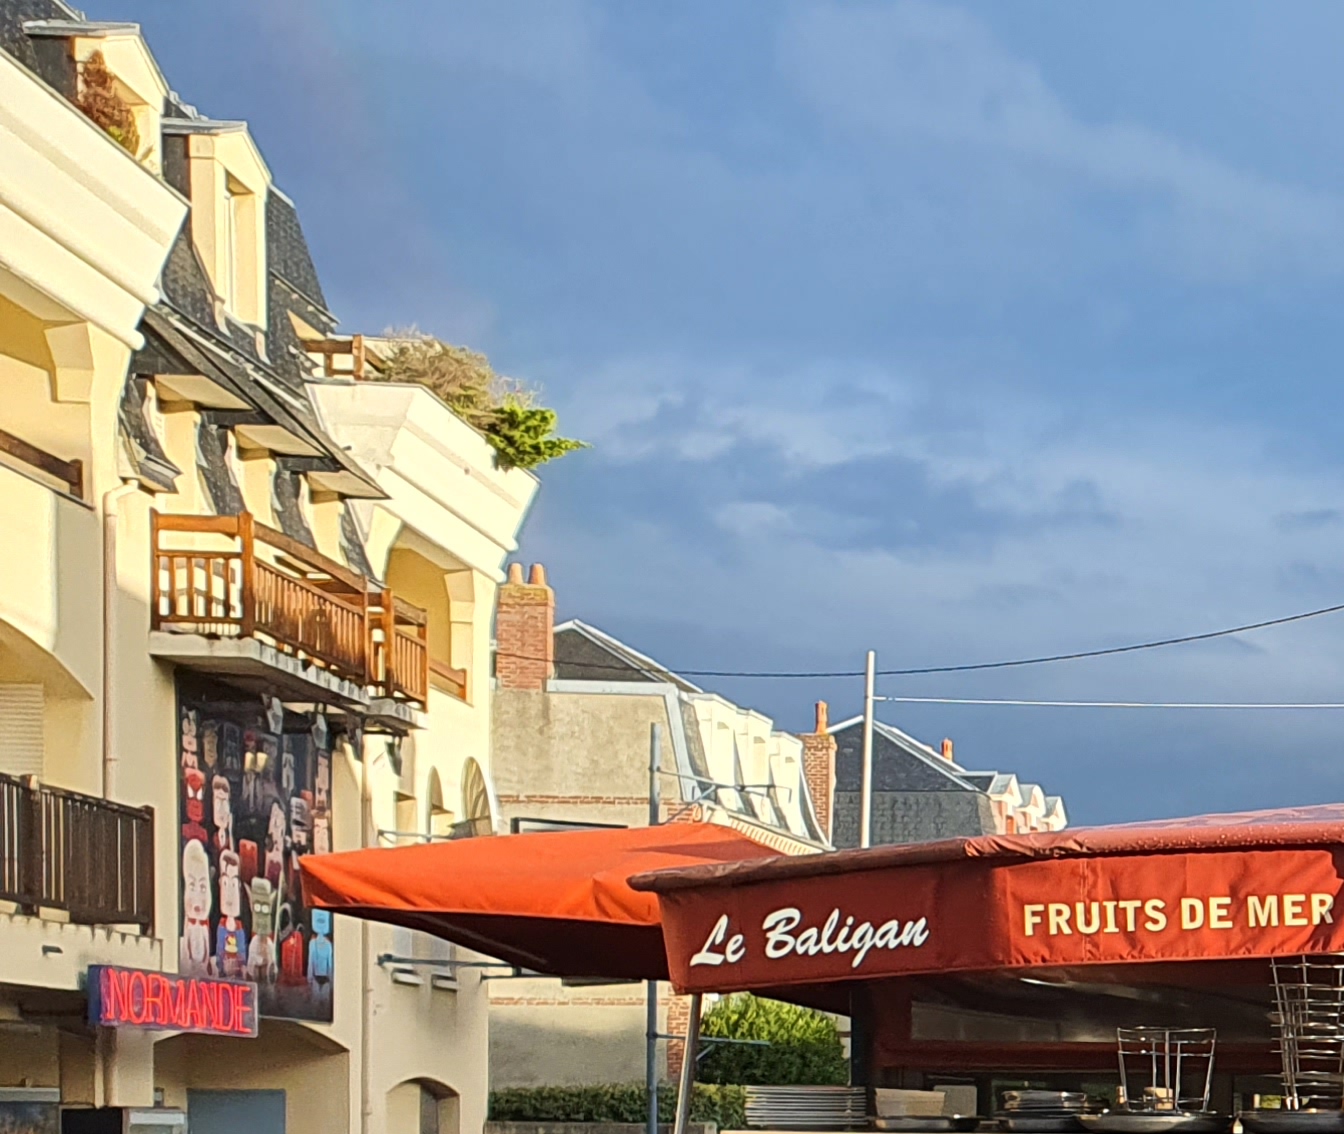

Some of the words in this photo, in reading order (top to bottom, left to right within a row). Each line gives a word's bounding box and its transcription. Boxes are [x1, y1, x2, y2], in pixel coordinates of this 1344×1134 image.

[689, 914, 746, 966] Le
[762, 908, 929, 968] Baligan
[1024, 899, 1168, 936] FRUITS
[1181, 897, 1234, 930] DE
[1247, 893, 1335, 928] MER
[107, 968, 252, 1033] NORMANDIE
